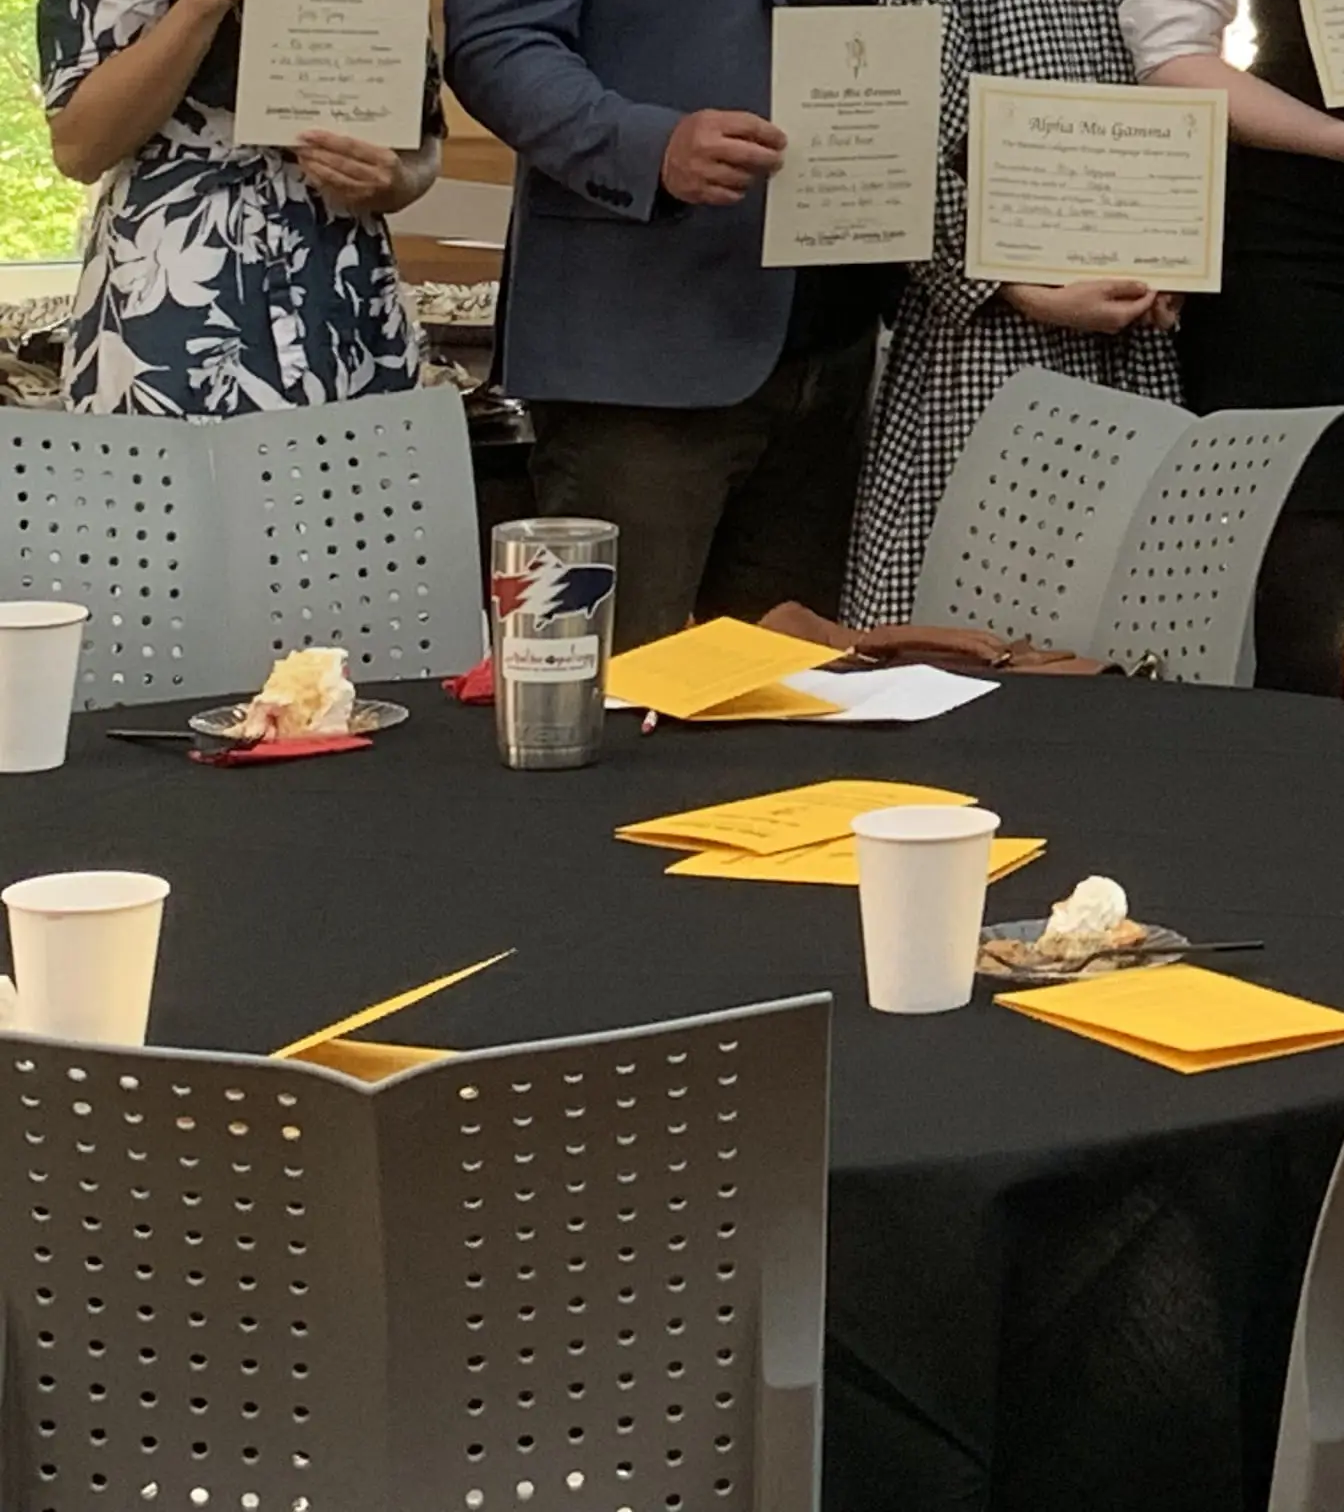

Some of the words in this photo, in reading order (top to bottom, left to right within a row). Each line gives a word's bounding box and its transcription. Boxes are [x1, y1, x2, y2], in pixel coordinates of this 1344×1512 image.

[1029, 116, 1074, 139] Alpha
[1080, 121, 1107, 136] Mu
[1112, 122, 1171, 140] Gamma
